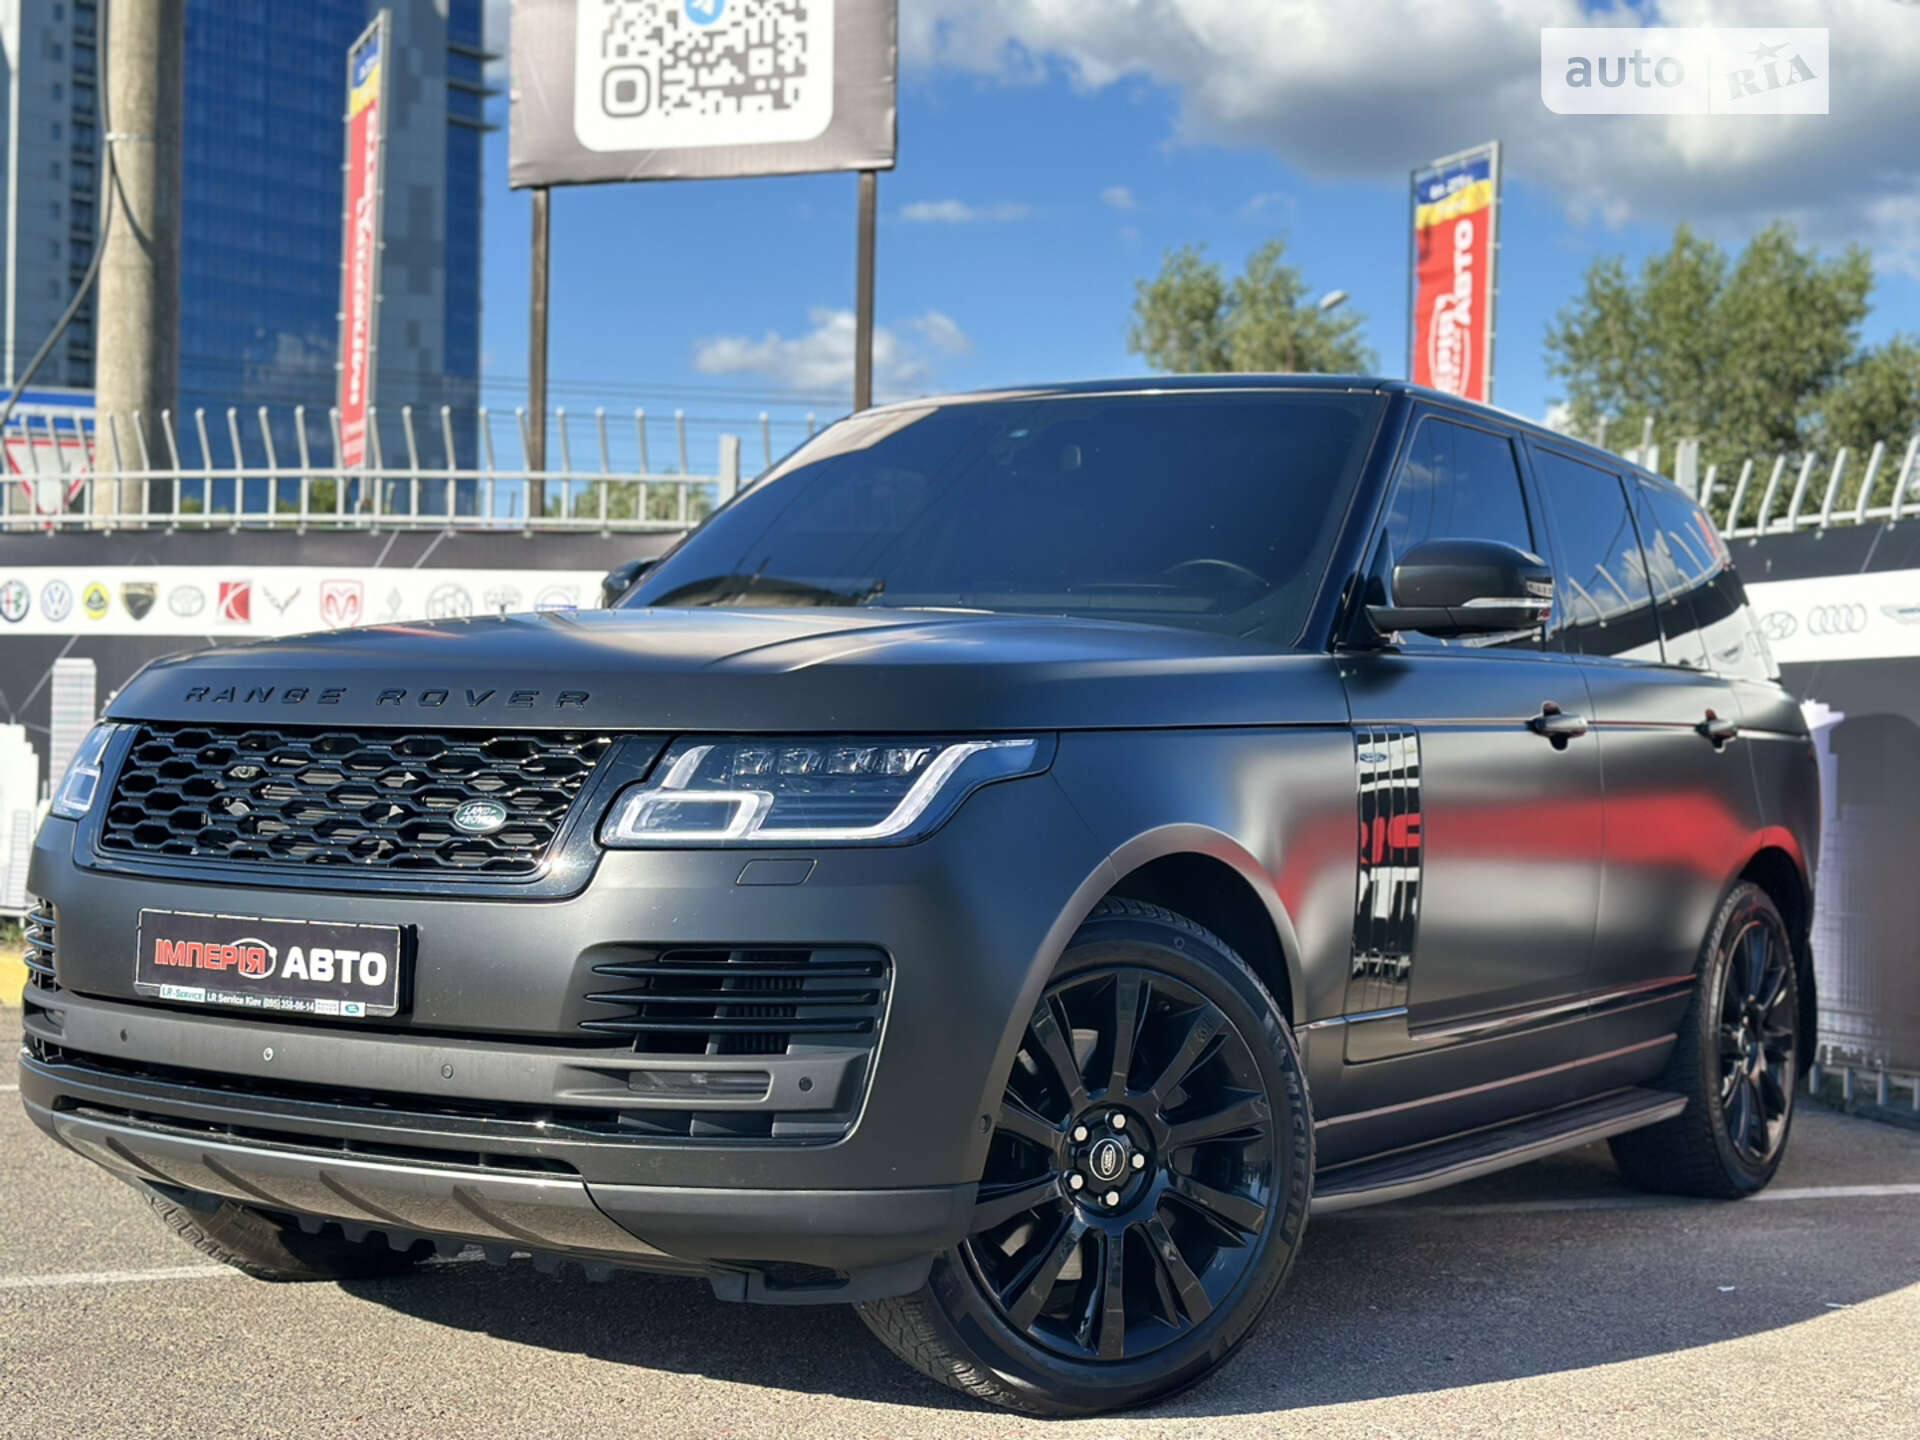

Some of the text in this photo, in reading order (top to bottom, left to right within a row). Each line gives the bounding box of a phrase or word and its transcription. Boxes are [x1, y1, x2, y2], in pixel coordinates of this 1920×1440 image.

[1453, 219, 1474, 327] АВТО
[182, 685, 593, 710] RANGE ROVER
[153, 938, 388, 987] ІМПЕРІЯ АВТО
